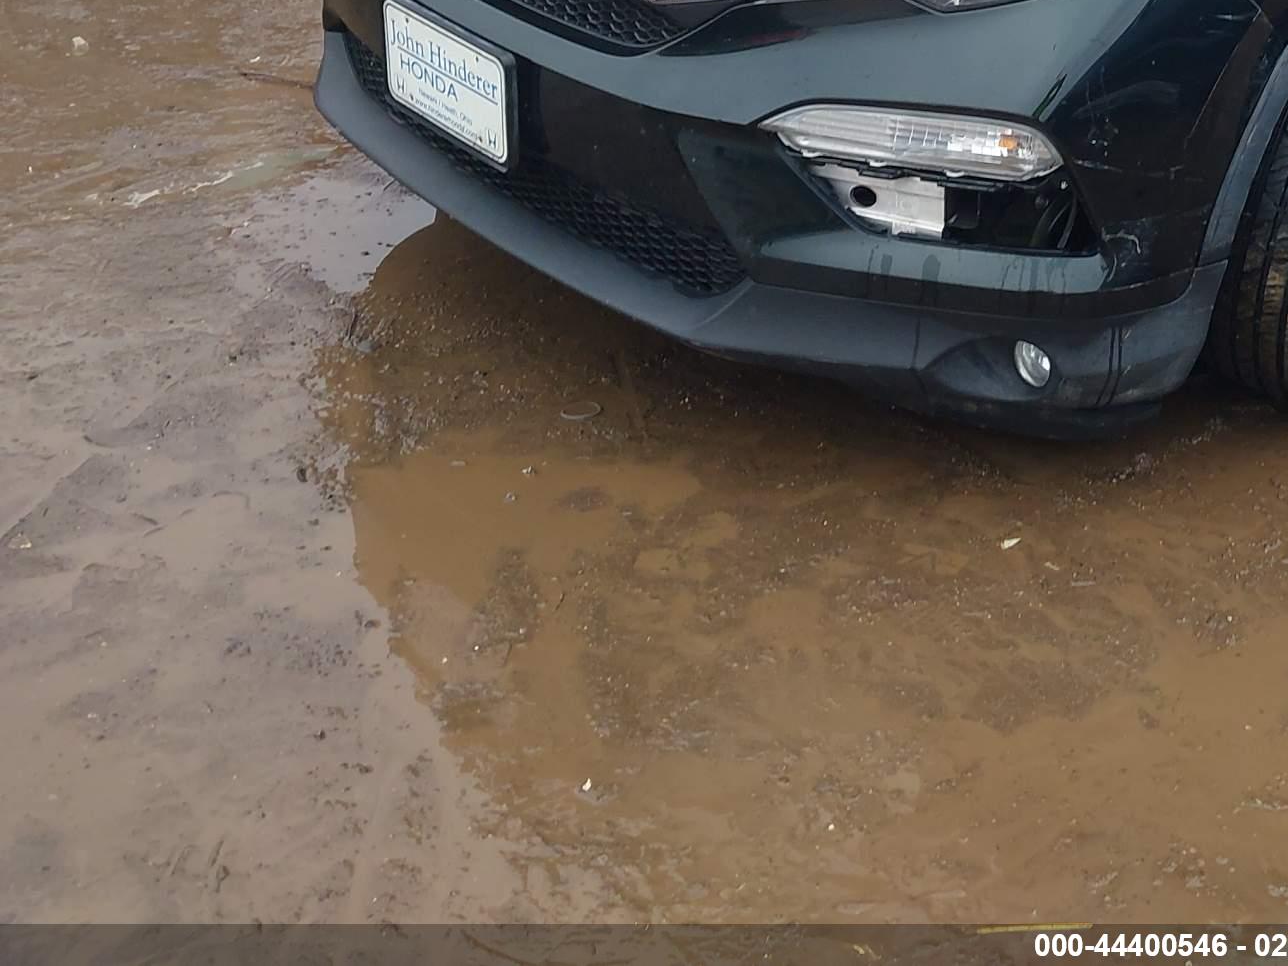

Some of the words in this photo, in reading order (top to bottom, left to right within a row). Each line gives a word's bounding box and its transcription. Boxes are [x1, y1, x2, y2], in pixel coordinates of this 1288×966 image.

[390, 19, 424, 59] John
[428, 40, 498, 100] Hinderer
[399, 53, 459, 103] HONDA
